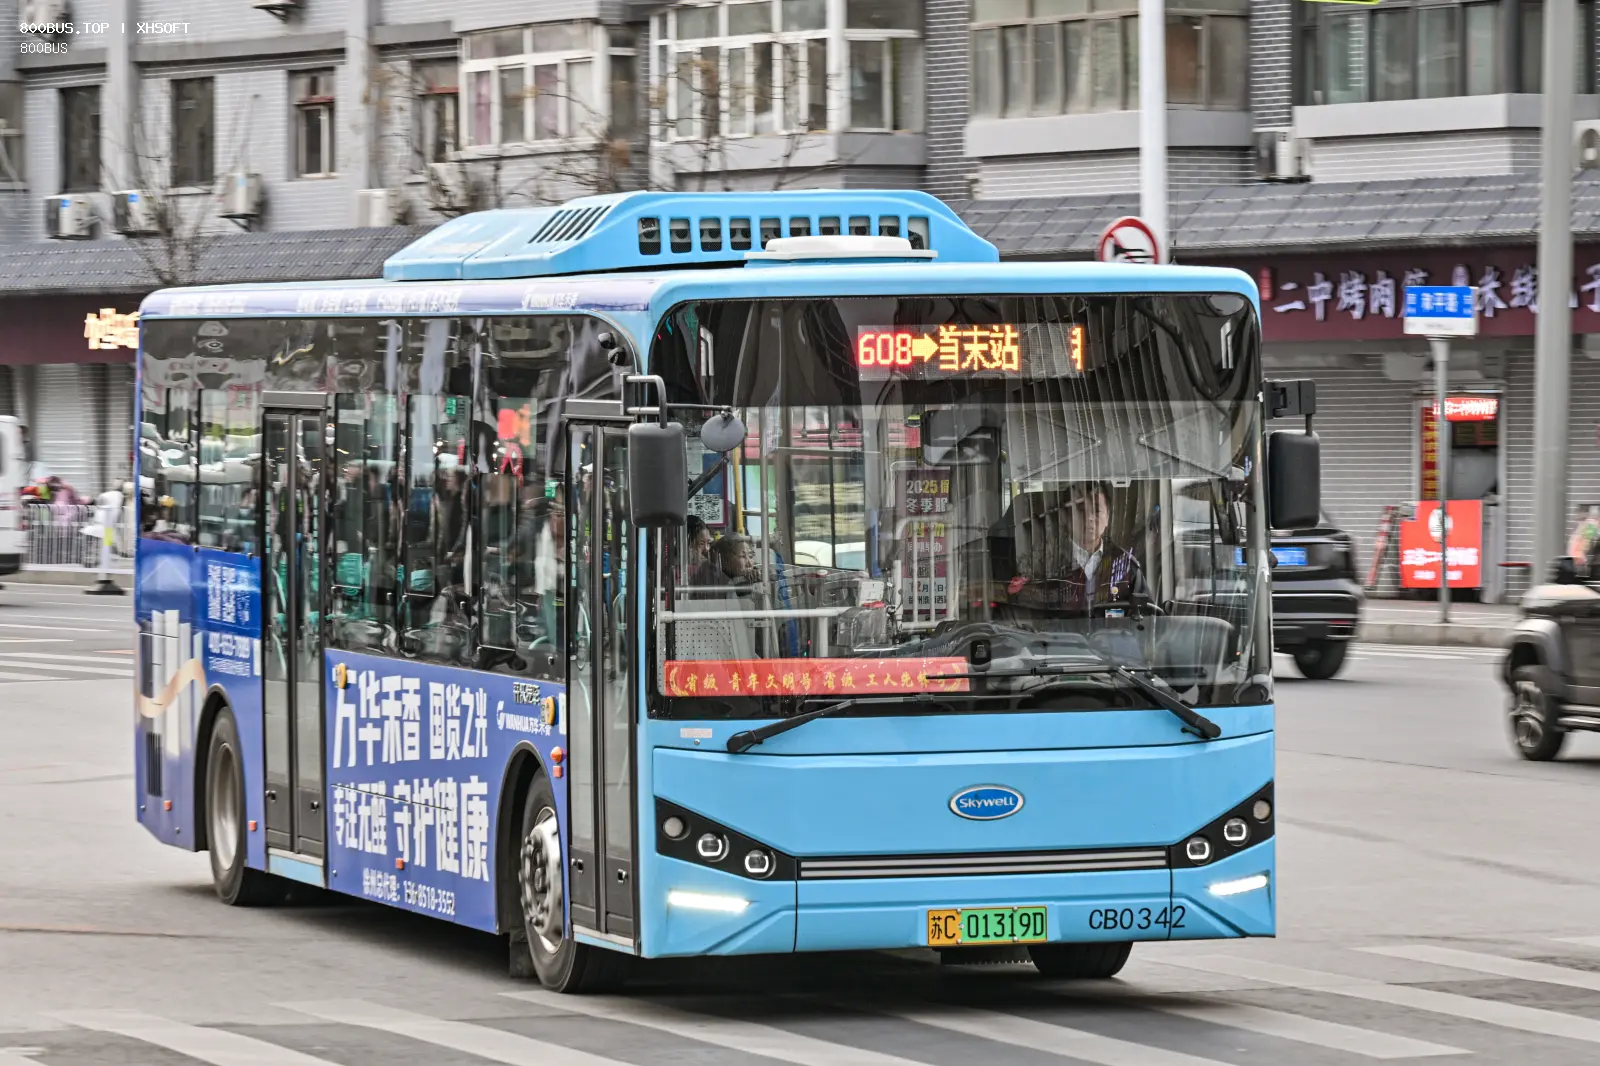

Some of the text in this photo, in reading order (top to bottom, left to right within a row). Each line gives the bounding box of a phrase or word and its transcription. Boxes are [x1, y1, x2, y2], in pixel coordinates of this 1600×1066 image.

[1272, 267, 1430, 322] 二中烤肉
[858, 333, 913, 366] 608
[938, 324, 1019, 371] 首末站
[729, 671, 812, 691] 青年文明号
[332, 668, 489, 768] 万华禾香 国货之光
[333, 775, 490, 882] 专注无醛 守护健康
[967, 911, 1045, 939] 01319D
